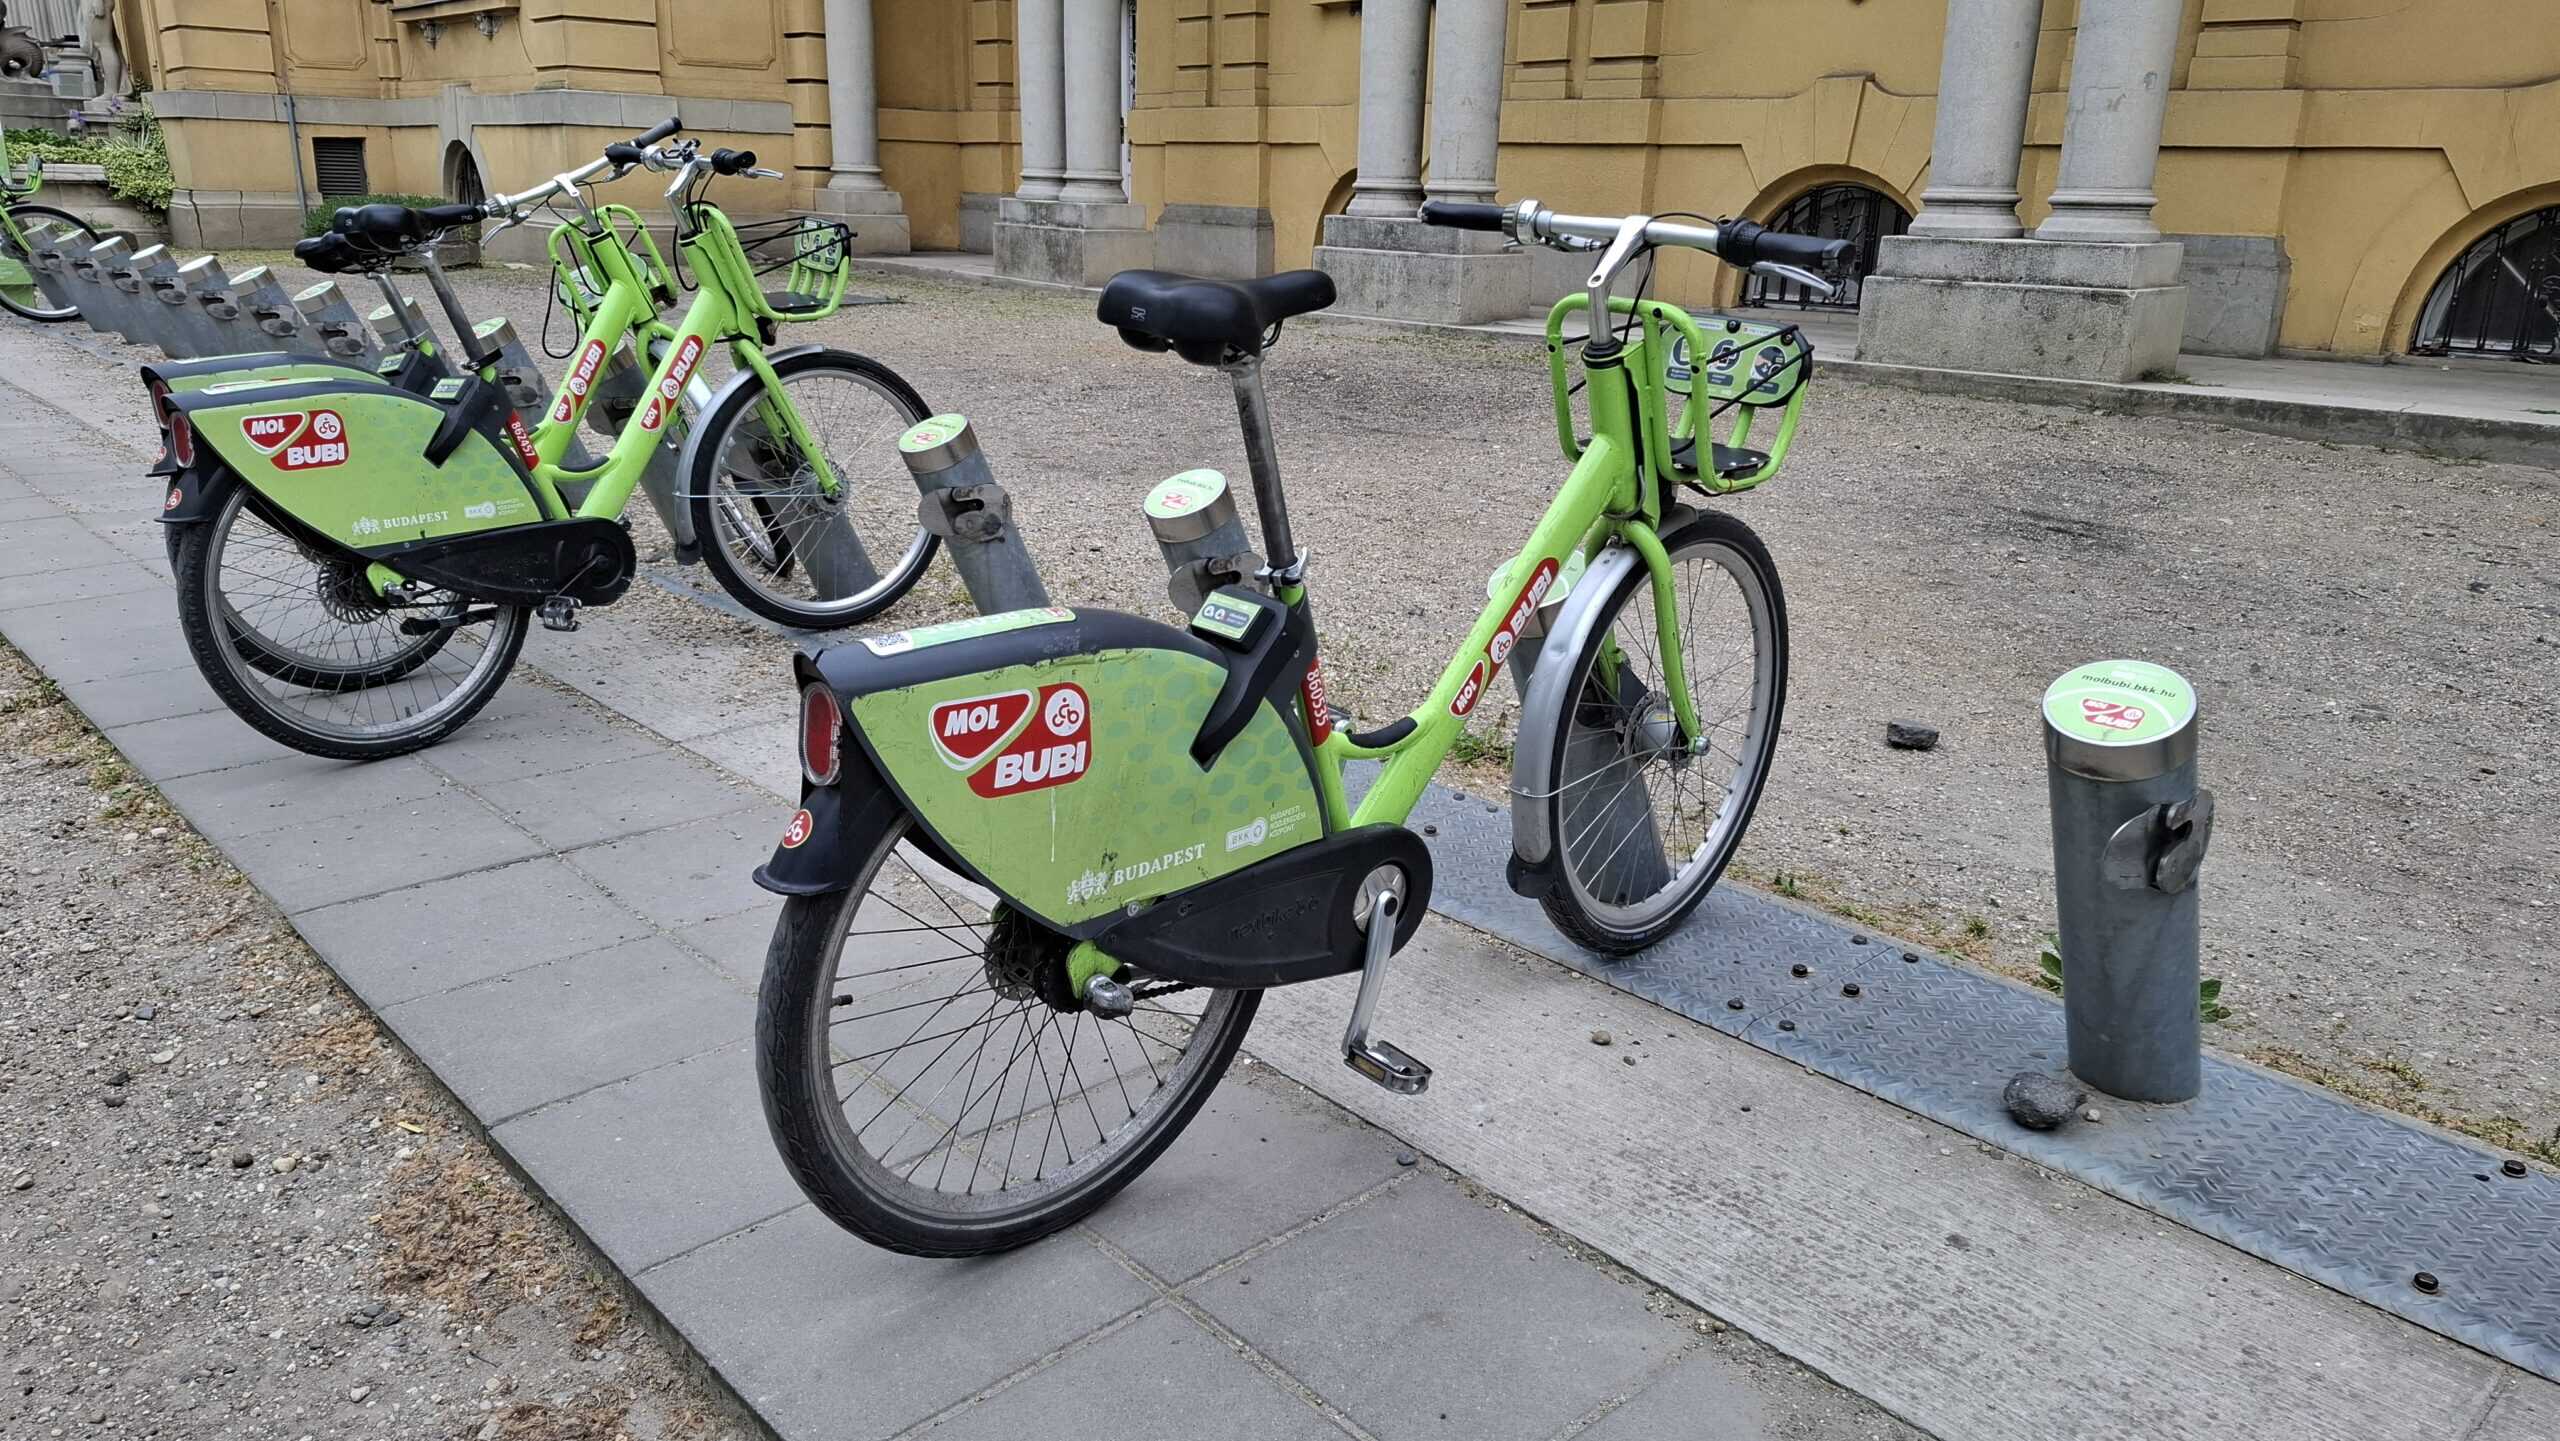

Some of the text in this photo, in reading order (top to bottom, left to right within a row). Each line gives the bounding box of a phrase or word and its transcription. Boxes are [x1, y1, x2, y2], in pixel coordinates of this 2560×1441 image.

[555, 343, 603, 421] MOL BUBI
[643, 339, 700, 428] MOL BUBI
[250, 418, 286, 436] MOL
[287, 442, 346, 466] BUBI
[383, 510, 449, 529] BUDAPEST
[1456, 566, 1553, 713] MOL BUBI
[1306, 668, 1329, 727] 860535
[2081, 674, 2177, 698] molbubi.bkk.hu
[943, 704, 1000, 737] MOL
[993, 740, 1087, 789] BUBI
[1112, 843, 1206, 886] BUDAPEST
